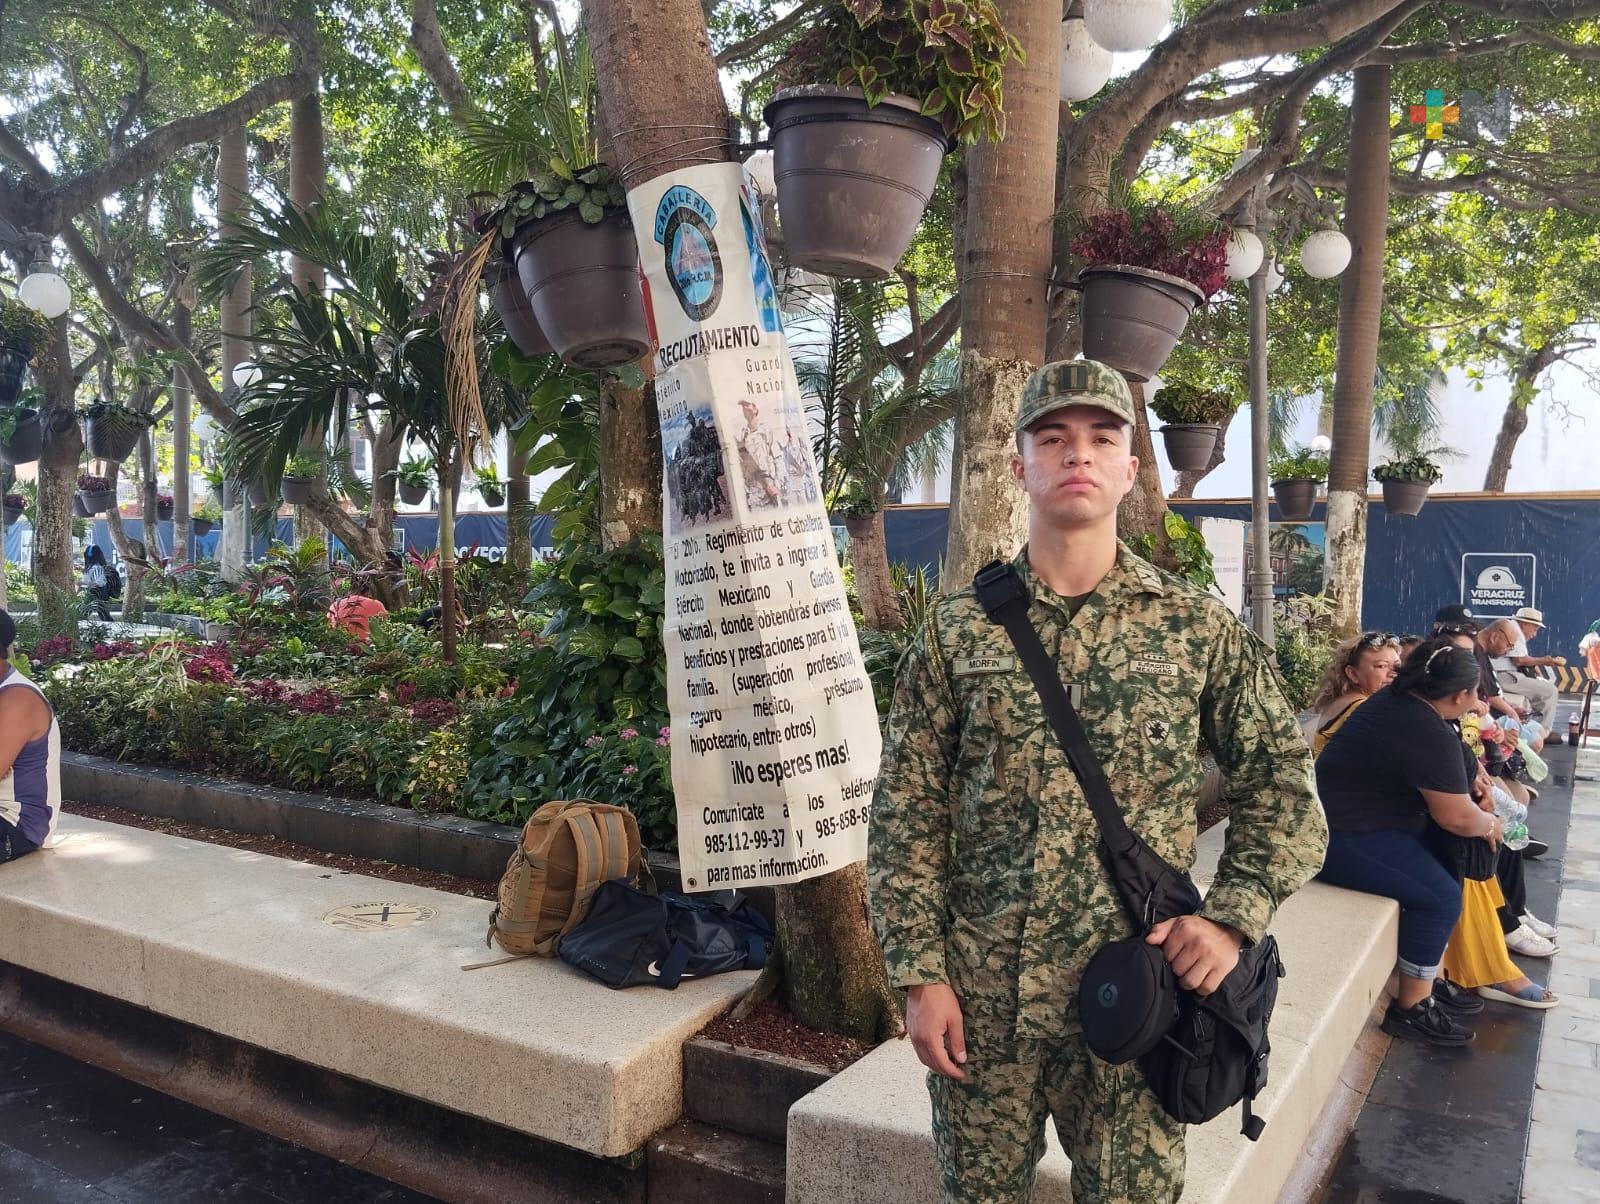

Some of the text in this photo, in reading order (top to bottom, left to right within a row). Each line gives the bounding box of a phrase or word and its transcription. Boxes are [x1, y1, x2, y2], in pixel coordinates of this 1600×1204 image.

[659, 324, 760, 369] RECLUTAMIENTO
[705, 526, 765, 553] Regimiento
[770, 521, 784, 538] de
[674, 564, 719, 587] Motorizado,
[723, 560, 736, 577] te
[740, 551, 771, 575] invita
[777, 552, 784, 567] a
[822, 540, 828, 558] al
[676, 592, 705, 617] Ejército
[718, 584, 771, 607] Mexicano
[786, 579, 794, 599] y
[1471, 589, 1525, 599] VERACRUZ
[1471, 599, 1523, 607] TRANSFORMA
[678, 597, 842, 642] Nacional, donde obtendrás diversos
[684, 647, 728, 670] beneficios
[728, 649, 736, 667] y
[738, 635, 805, 667] prestaciones
[806, 629, 827, 651] para
[828, 622, 837, 642] ti
[687, 650, 856, 698] familia. (superación profesional,
[1135, 666, 1173, 675] MEXICANO
[1137, 661, 1172, 670] EJERCITO
[689, 676, 864, 728] seguro médico, préstamo
[689, 715, 817, 756] hipotecario, entre otros)
[731, 739, 851, 787] ¡No esperes mas!
[703, 802, 765, 826] Comunicate
[783, 803, 790, 818] a
[807, 793, 825, 812] los
[796, 829, 803, 848] y
[707, 849, 829, 886] para mas información.
